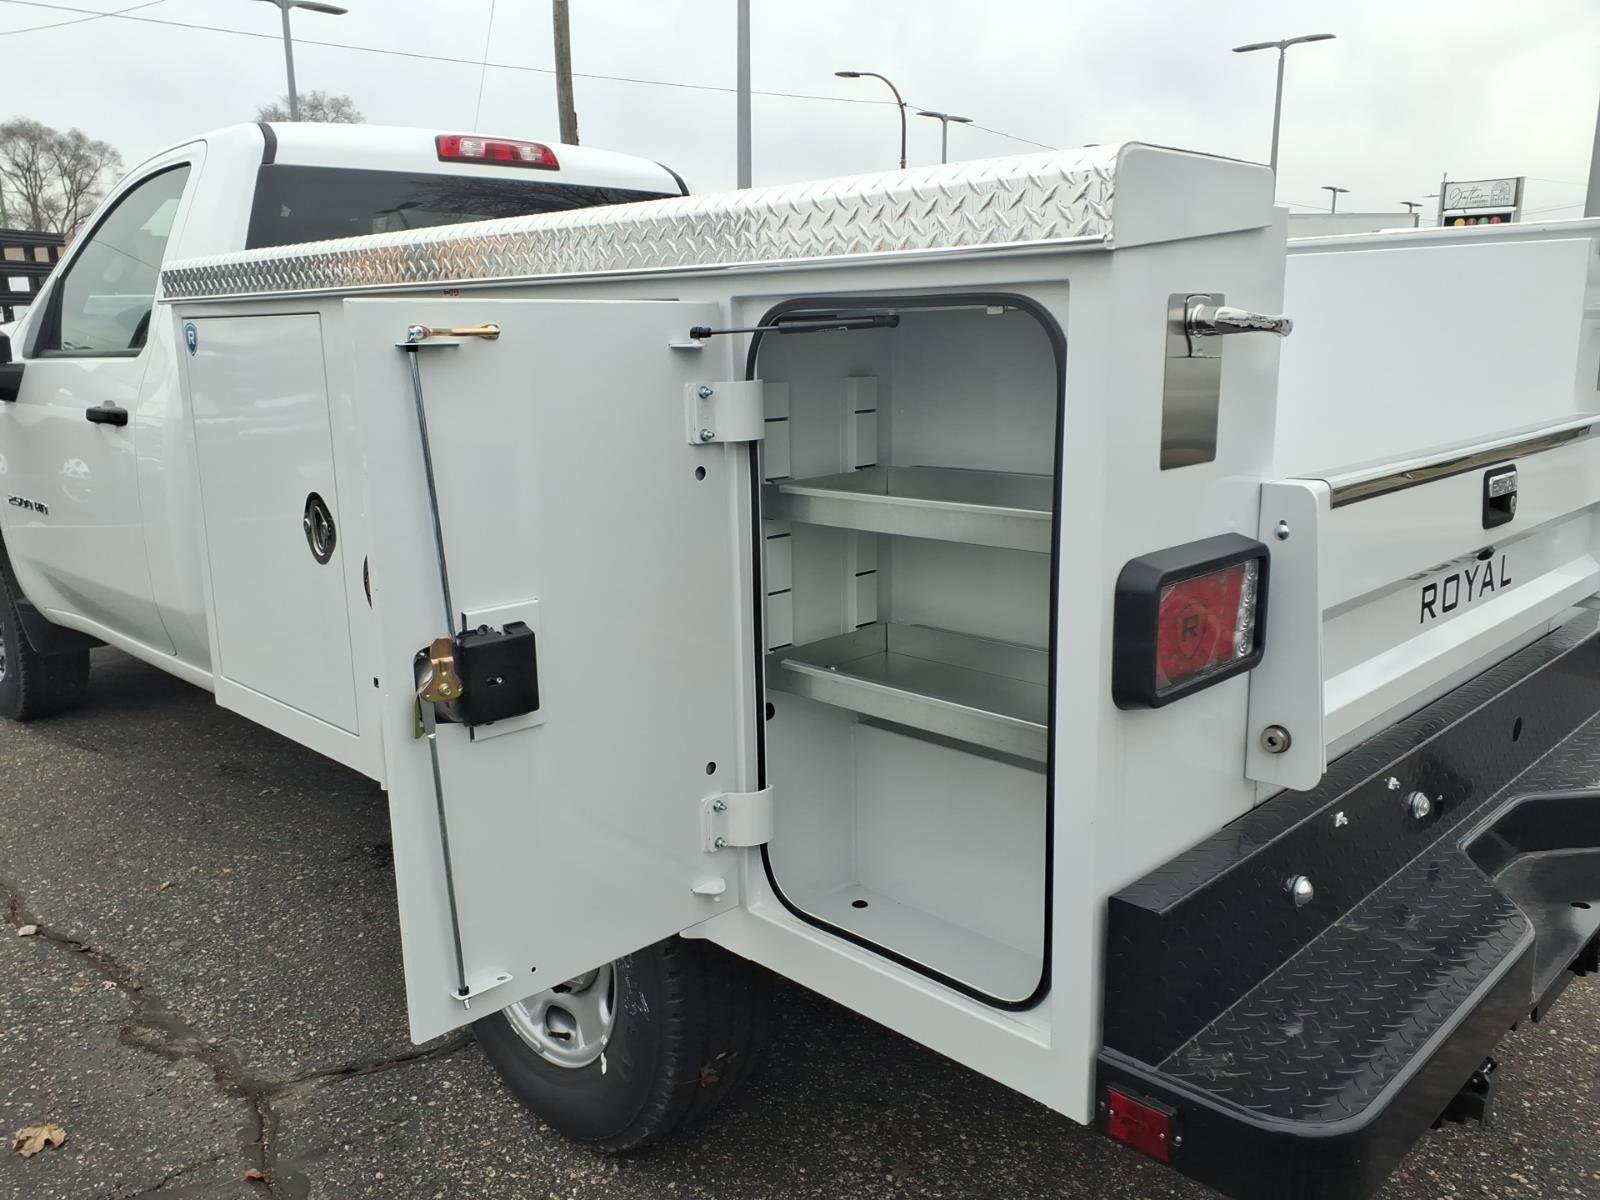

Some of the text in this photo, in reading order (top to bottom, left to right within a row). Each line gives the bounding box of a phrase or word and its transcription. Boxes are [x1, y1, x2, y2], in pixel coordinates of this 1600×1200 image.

[187, 330, 196, 345] R
[1420, 554, 1512, 624] ROYAL
[1181, 614, 1200, 641] R
